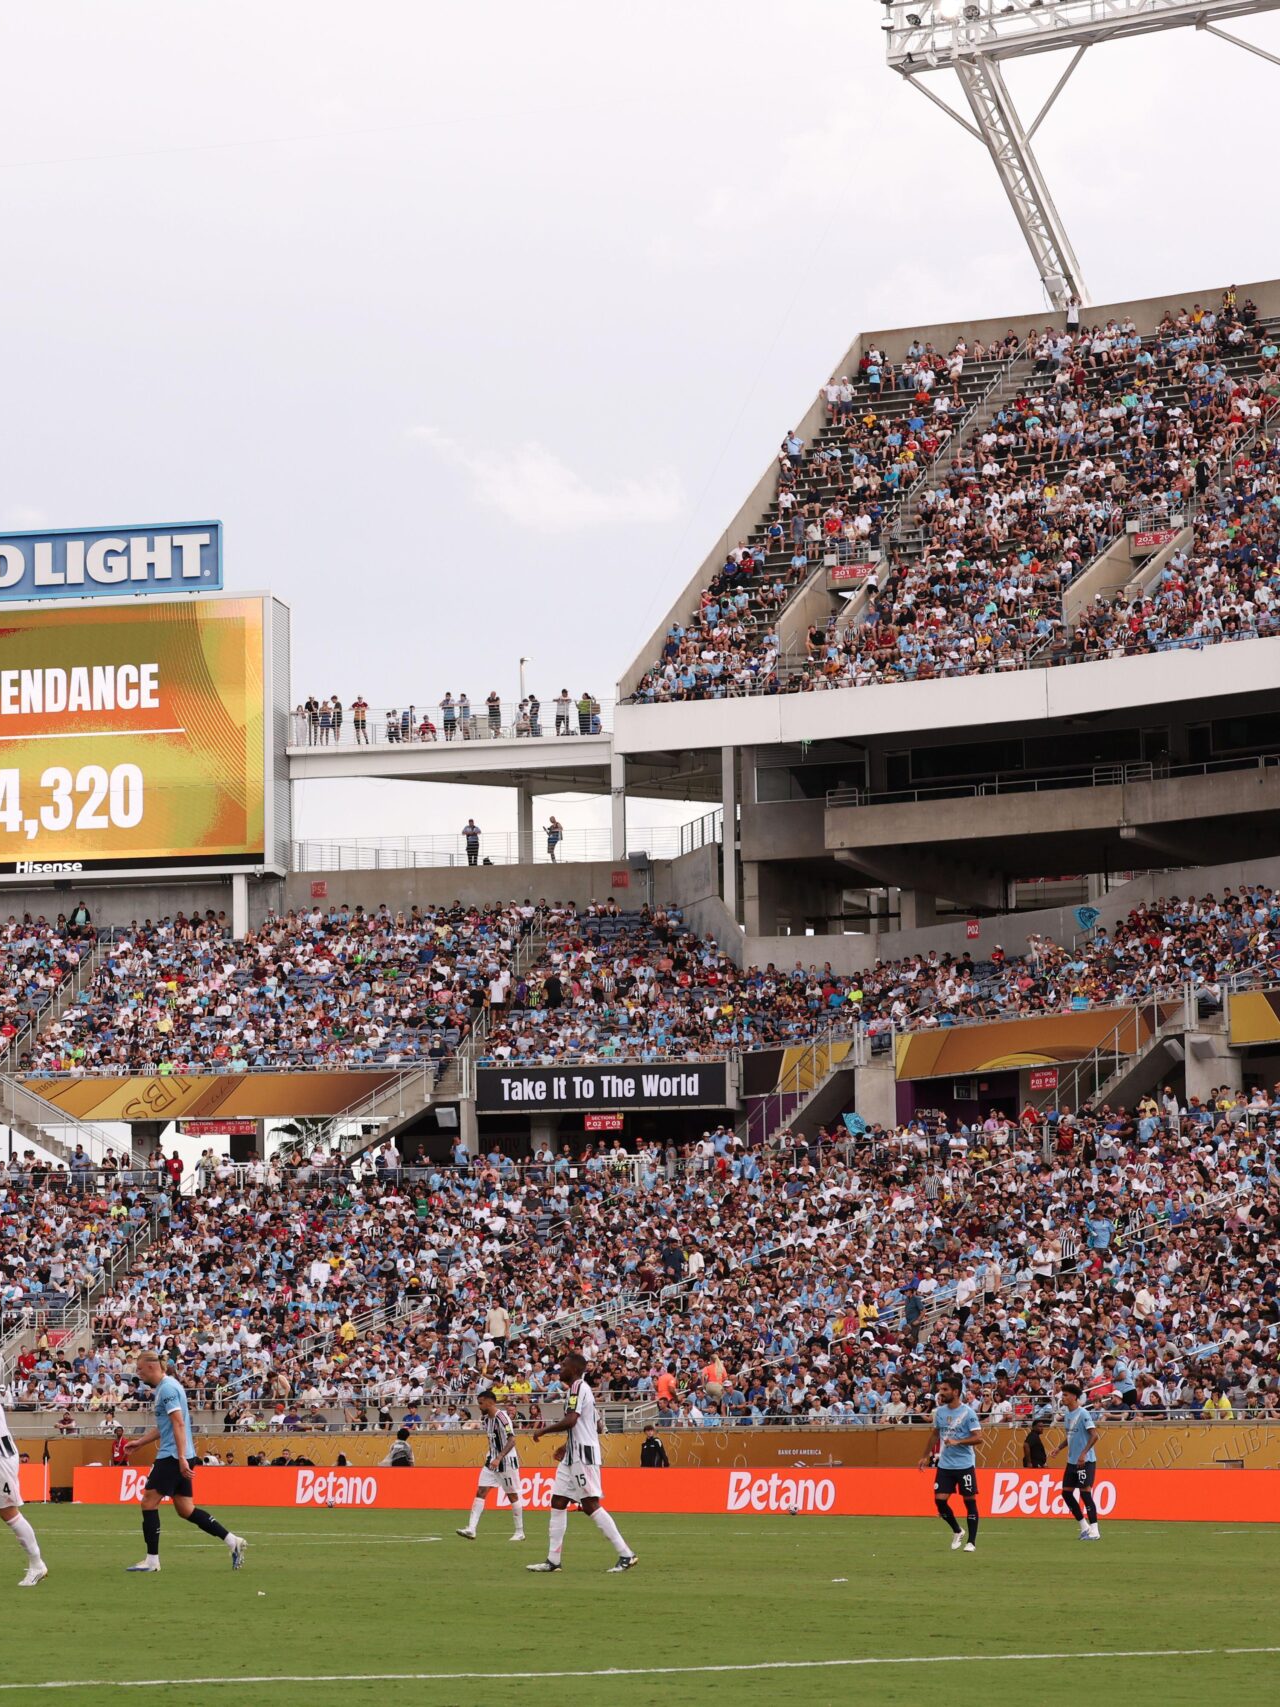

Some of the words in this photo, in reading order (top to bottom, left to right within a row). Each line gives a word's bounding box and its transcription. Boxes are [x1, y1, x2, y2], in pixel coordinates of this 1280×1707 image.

[35, 533, 210, 585] LIGHT
[16, 861, 83, 874] Hisense
[968, 925, 979, 935] P02
[501, 1078, 546, 1100] Take
[553, 1077, 567, 1099] It
[573, 1077, 595, 1098] To
[601, 1075, 635, 1098] The
[642, 1073, 699, 1096] World
[504, 1477, 513, 1487] 11
[575, 1474, 586, 1487] 15
[963, 1474, 972, 1487] 19
[3, 1483, 11, 1495] 4
[295, 1470, 377, 1505] Betano
[727, 1471, 836, 1512] Betano
